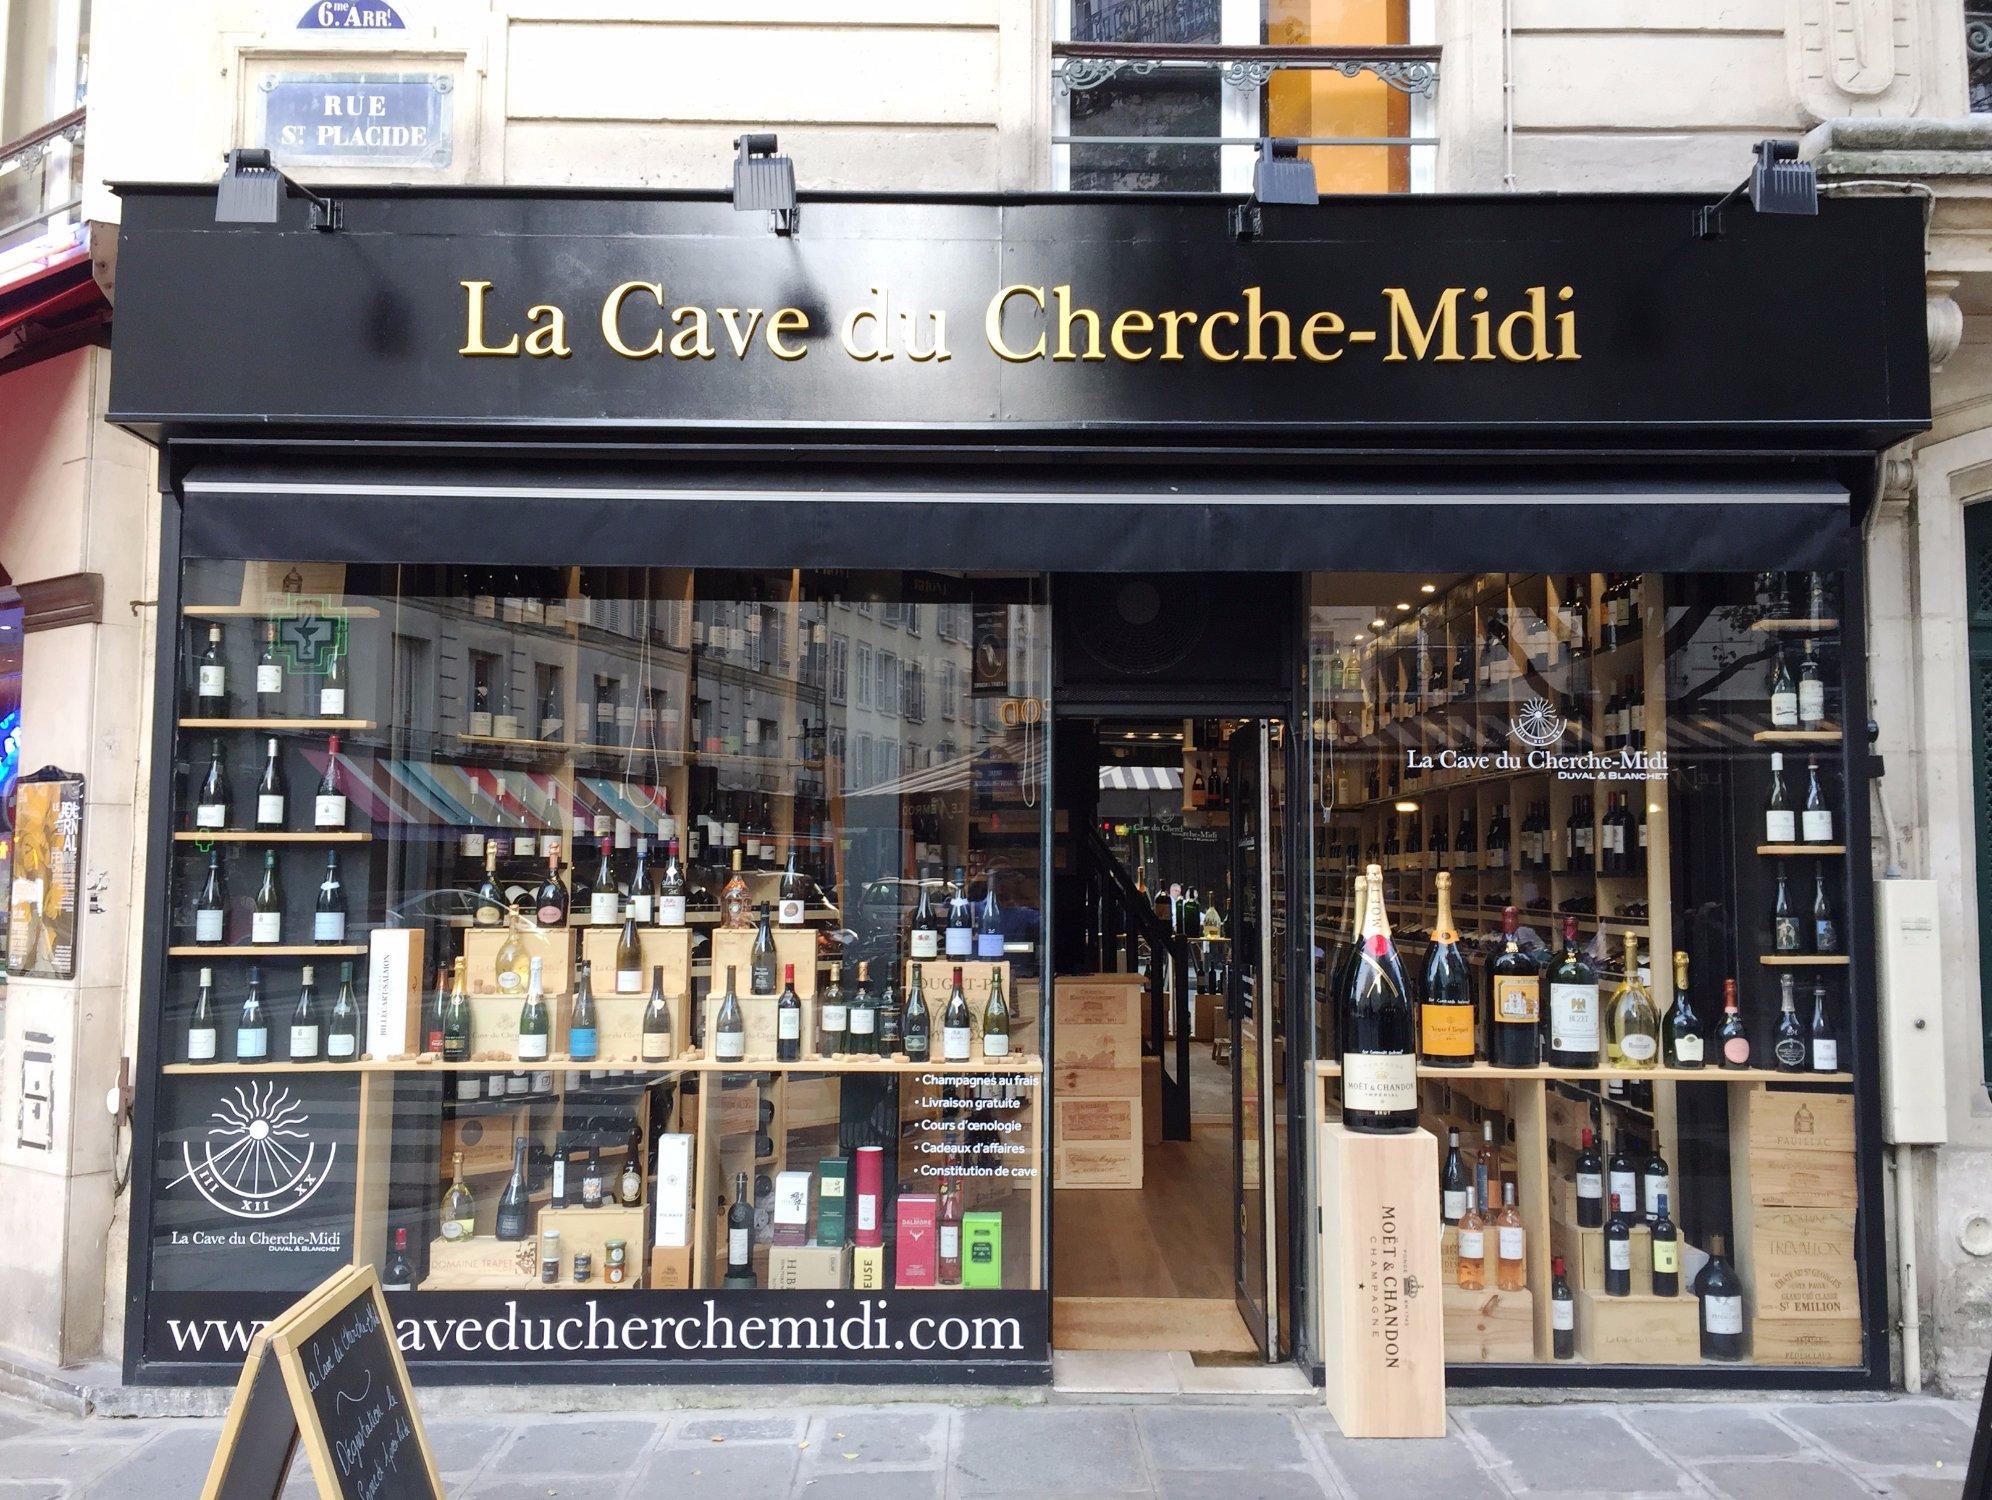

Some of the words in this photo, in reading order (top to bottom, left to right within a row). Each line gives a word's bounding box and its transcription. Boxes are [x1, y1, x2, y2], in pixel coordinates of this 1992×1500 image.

[324, 95, 386, 117] RUE
[317, 126, 428, 147] PLACIDE
[459, 281, 571, 358] La
[601, 281, 810, 361] Cave
[840, 288, 951, 362] du
[985, 284, 1582, 364] Cherche-Midi
[1407, 750, 1433, 769] La
[1439, 750, 1490, 769] Cave
[1495, 750, 1521, 769] du
[1528, 750, 1669, 770] Cherche-Midi
[1599, 772, 1606, 780] &
[922, 1074, 997, 1088] Champagnes
[999, 1077, 1014, 1086] au
[1014, 1074, 1040, 1086] frais
[922, 1097, 974, 1109] Livraison
[975, 1098, 1021, 1111] gratuite
[921, 1120, 956, 1132] Cours
[921, 1142, 971, 1154] Cadeaux
[920, 1165, 993, 1177] Constitution
[994, 1165, 1011, 1177] de
[1012, 1168, 1038, 1177] cave
[240, 1199, 270, 1212] XII
[171, 1230, 189, 1246] La
[193, 1230, 226, 1246] Cave
[229, 1230, 246, 1246] du
[249, 1230, 340, 1246] Cherche-Midi
[1383, 1261, 1394, 1272] &
[1370, 1236, 1380, 1338] CHAMPAGNE
[1795, 1301, 1841, 1312] EMILION
[1383, 1276, 1400, 1369] CHANDON
